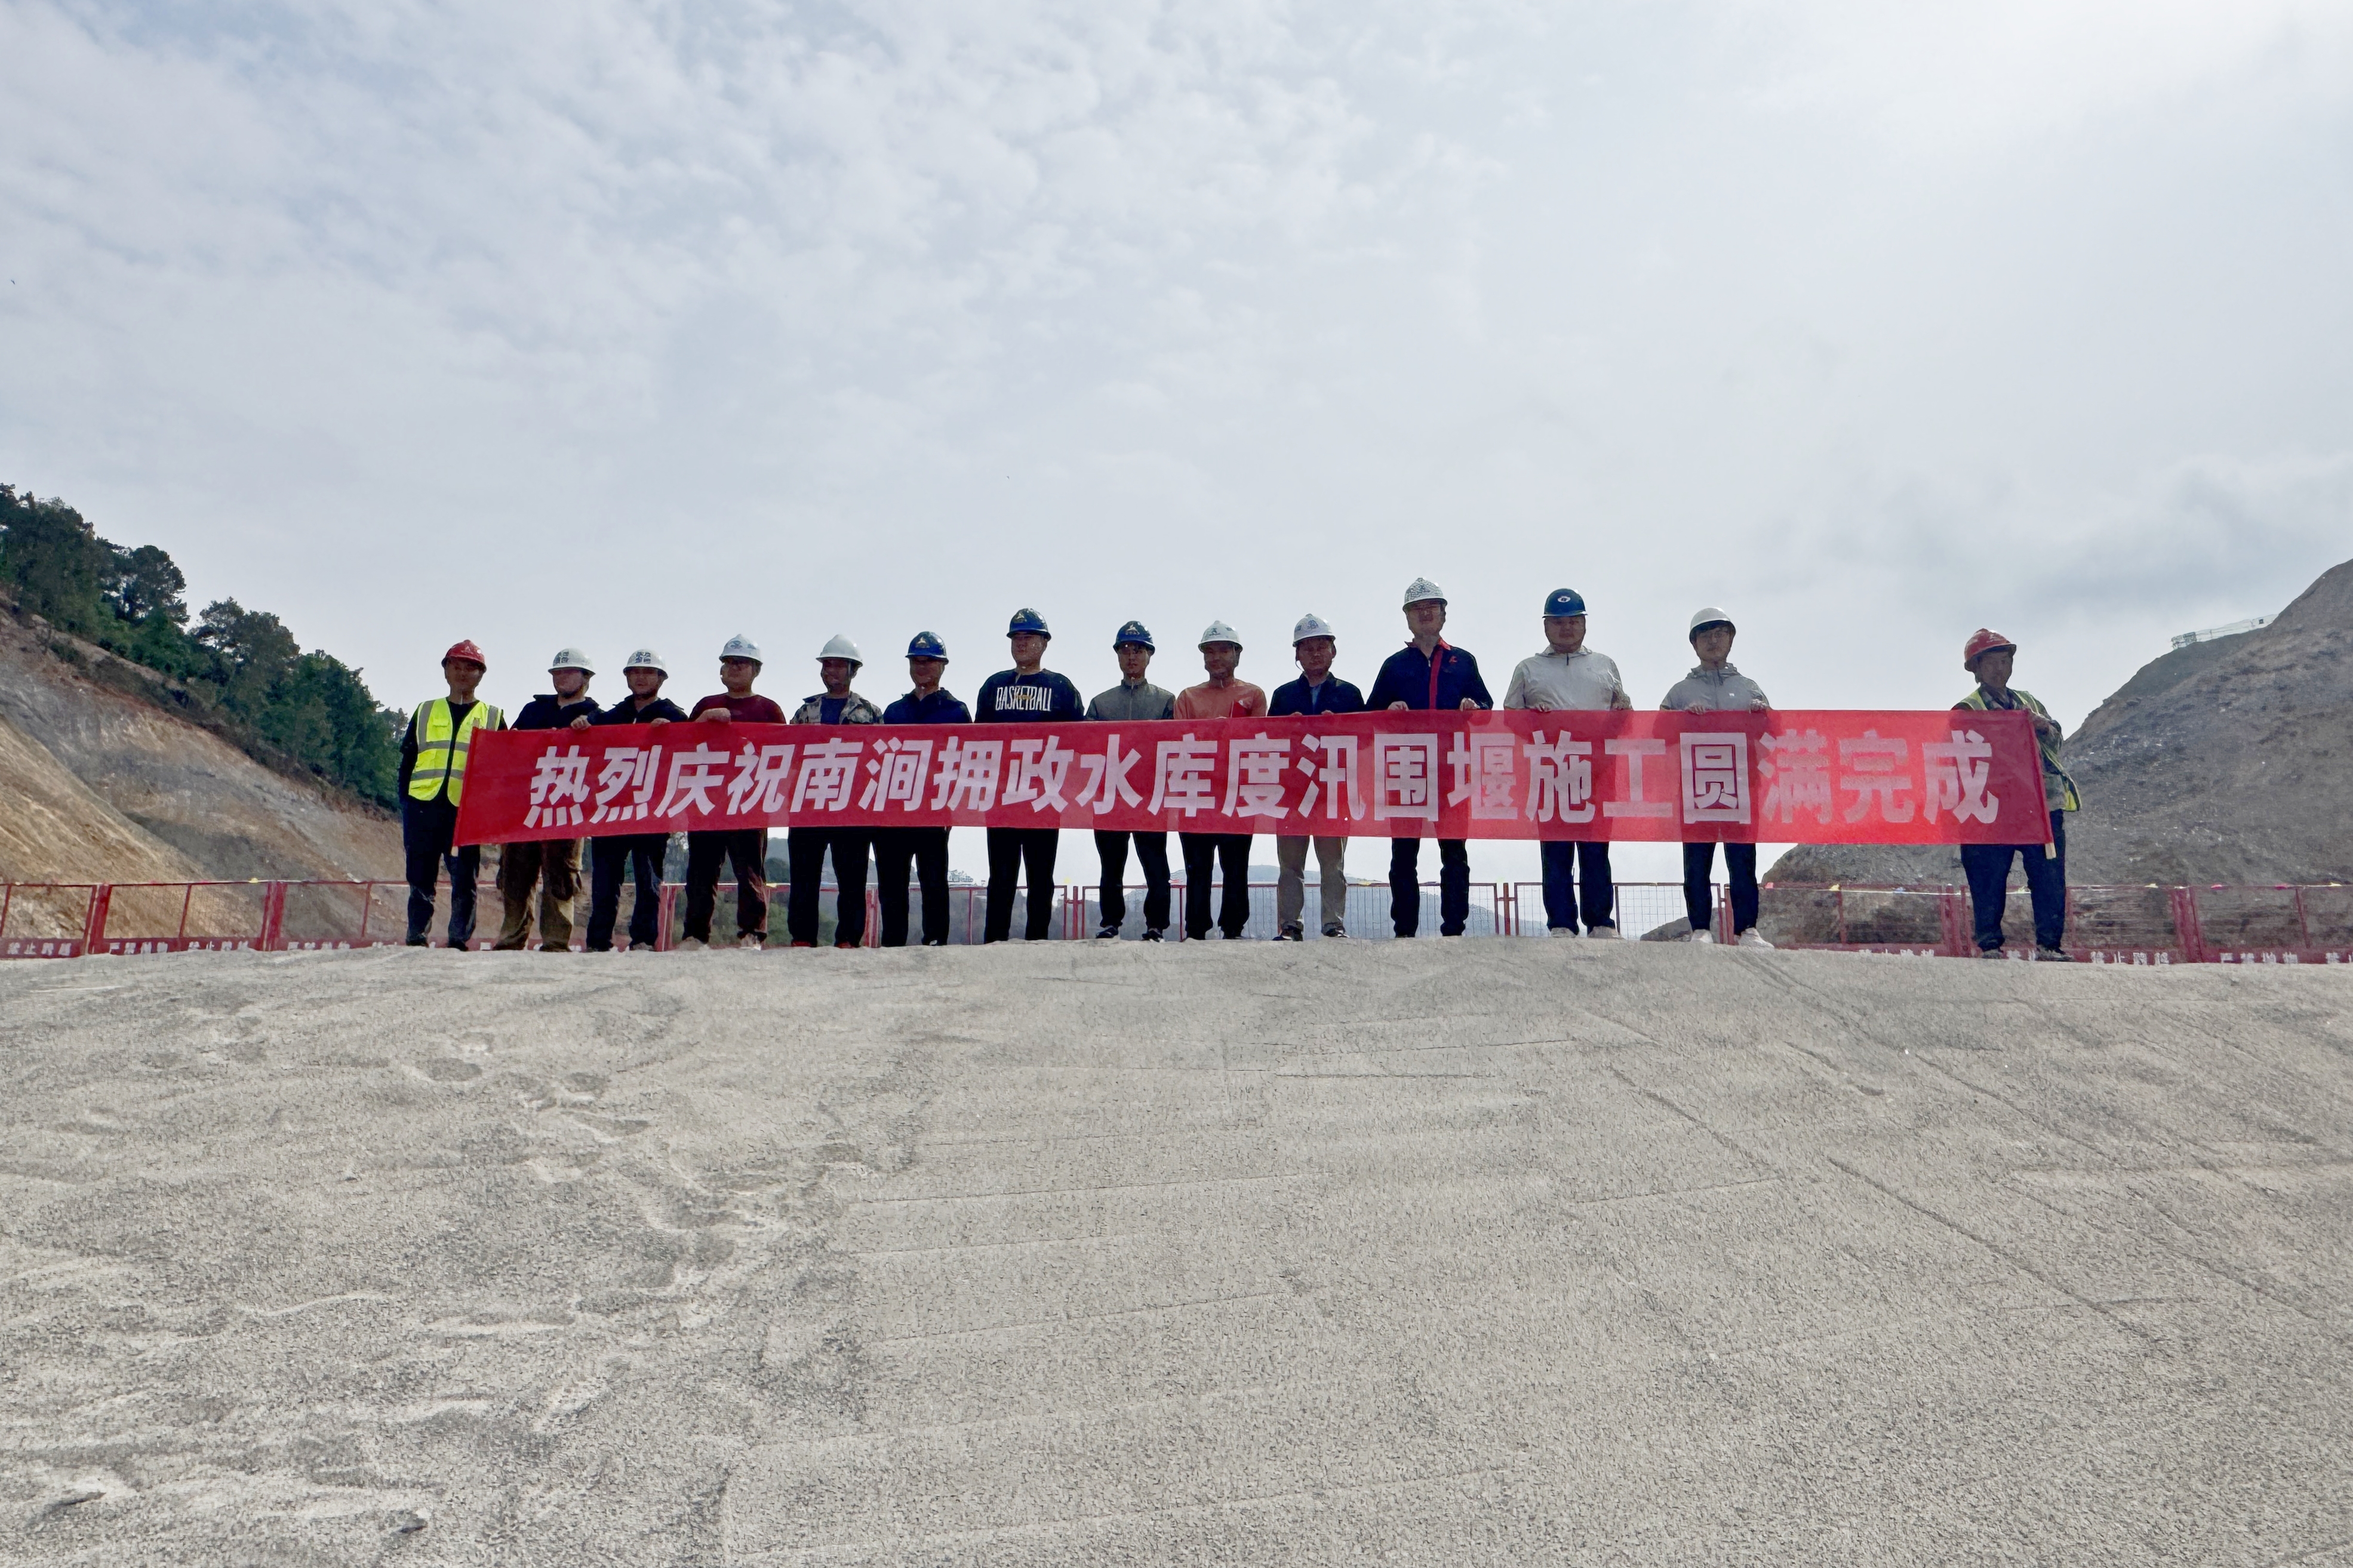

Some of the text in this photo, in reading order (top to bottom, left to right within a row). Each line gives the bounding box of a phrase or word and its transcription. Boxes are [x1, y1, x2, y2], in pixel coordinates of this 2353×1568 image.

[995, 686, 1052, 711] BASKETBALL
[523, 729, 2000, 828] 热烈庆祝南涧拥政水库度汛围堰施工圆满完成
